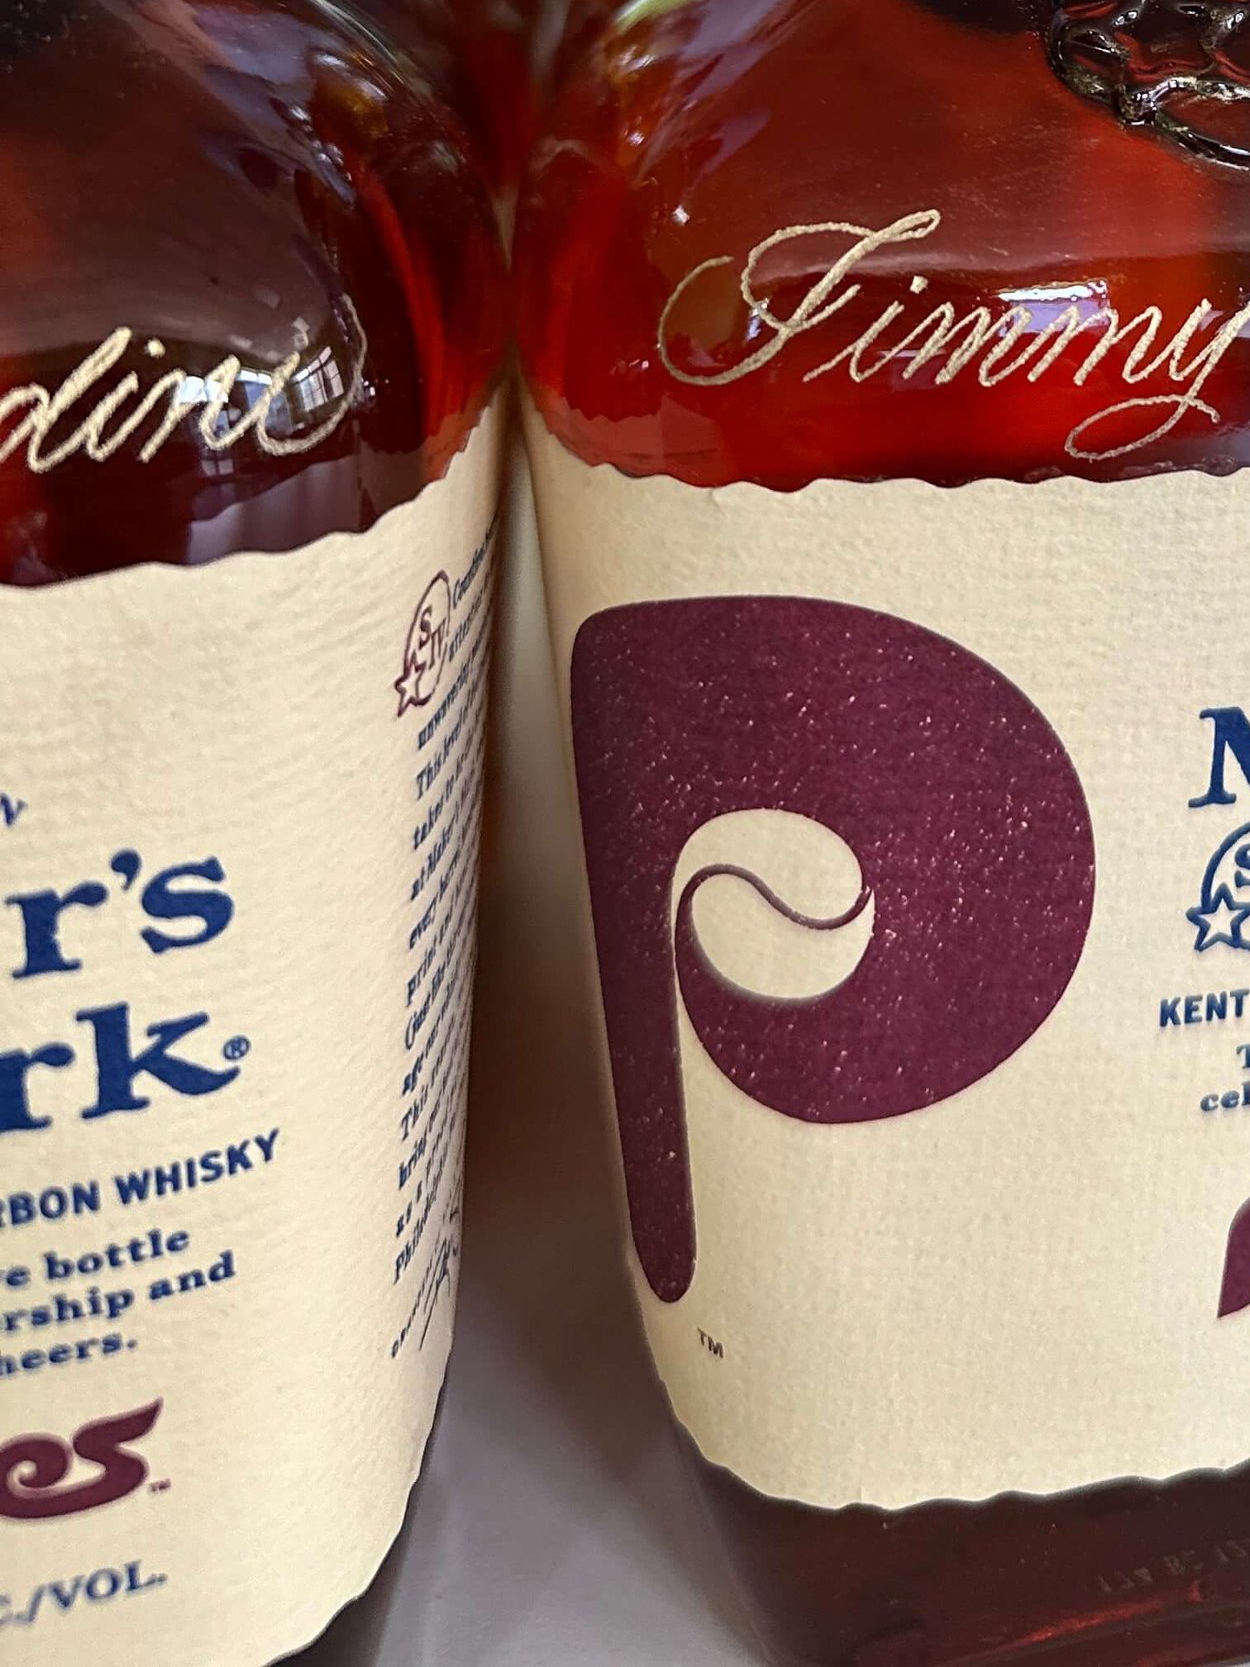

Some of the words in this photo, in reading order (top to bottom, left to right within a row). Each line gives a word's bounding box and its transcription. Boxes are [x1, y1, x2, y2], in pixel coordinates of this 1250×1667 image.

[571, 594, 1097, 1304] P
[0, 1179, 101, 1228] BON
[114, 1127, 280, 1205] WHISKY
[43, 1226, 191, 1281] bottle
[149, 1249, 237, 1301] and
